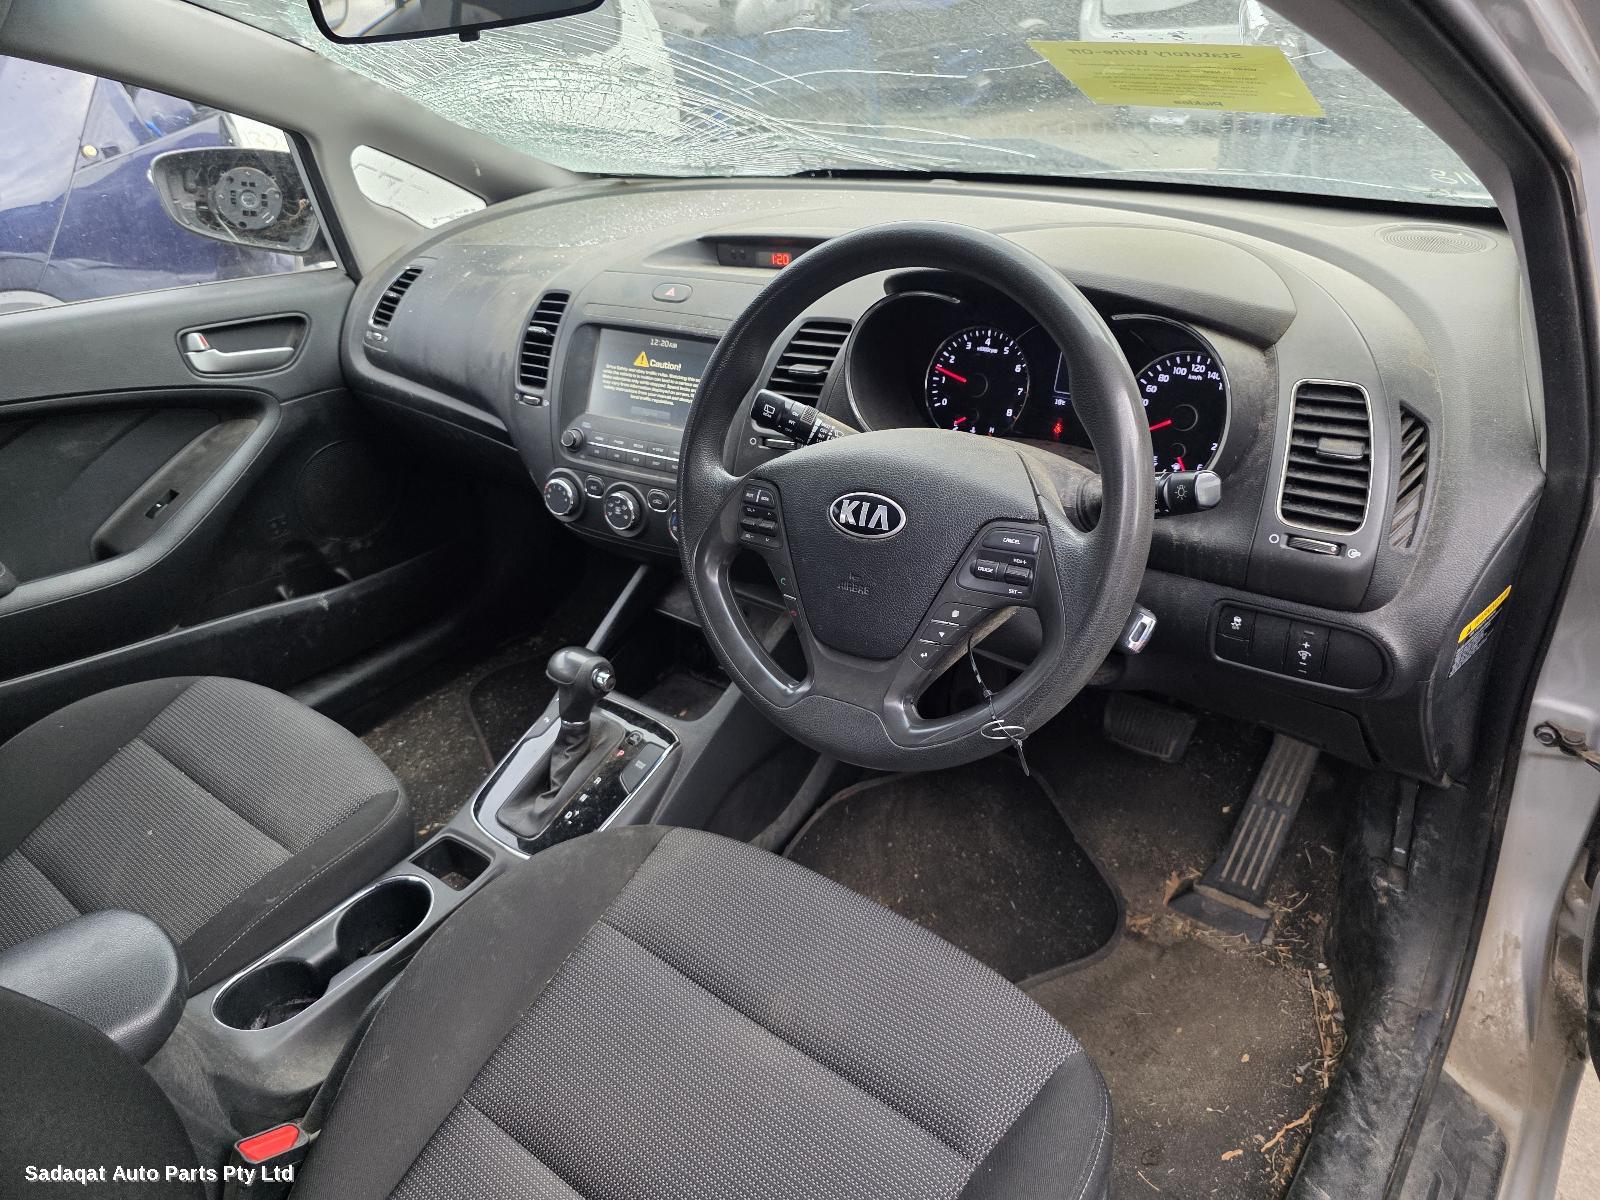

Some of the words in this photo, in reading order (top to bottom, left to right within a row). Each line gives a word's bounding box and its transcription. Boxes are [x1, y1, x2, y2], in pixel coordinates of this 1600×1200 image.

[966, 342, 972, 350] 3
[984, 338, 992, 346] 4
[1004, 346, 1010, 354] 5
[950, 356, 956, 364] 2
[649, 358, 682, 371] Caution!
[1014, 364, 1022, 372] 6
[1192, 364, 1206, 372] 120
[1172, 366, 1188, 376] 100
[1158, 374, 1170, 382] 80
[1018, 388, 1024, 396] 7
[1146, 384, 1158, 394] 60
[942, 398, 948, 406] 0
[1006, 408, 1012, 416] 8
[839, 499, 889, 531] KIA
